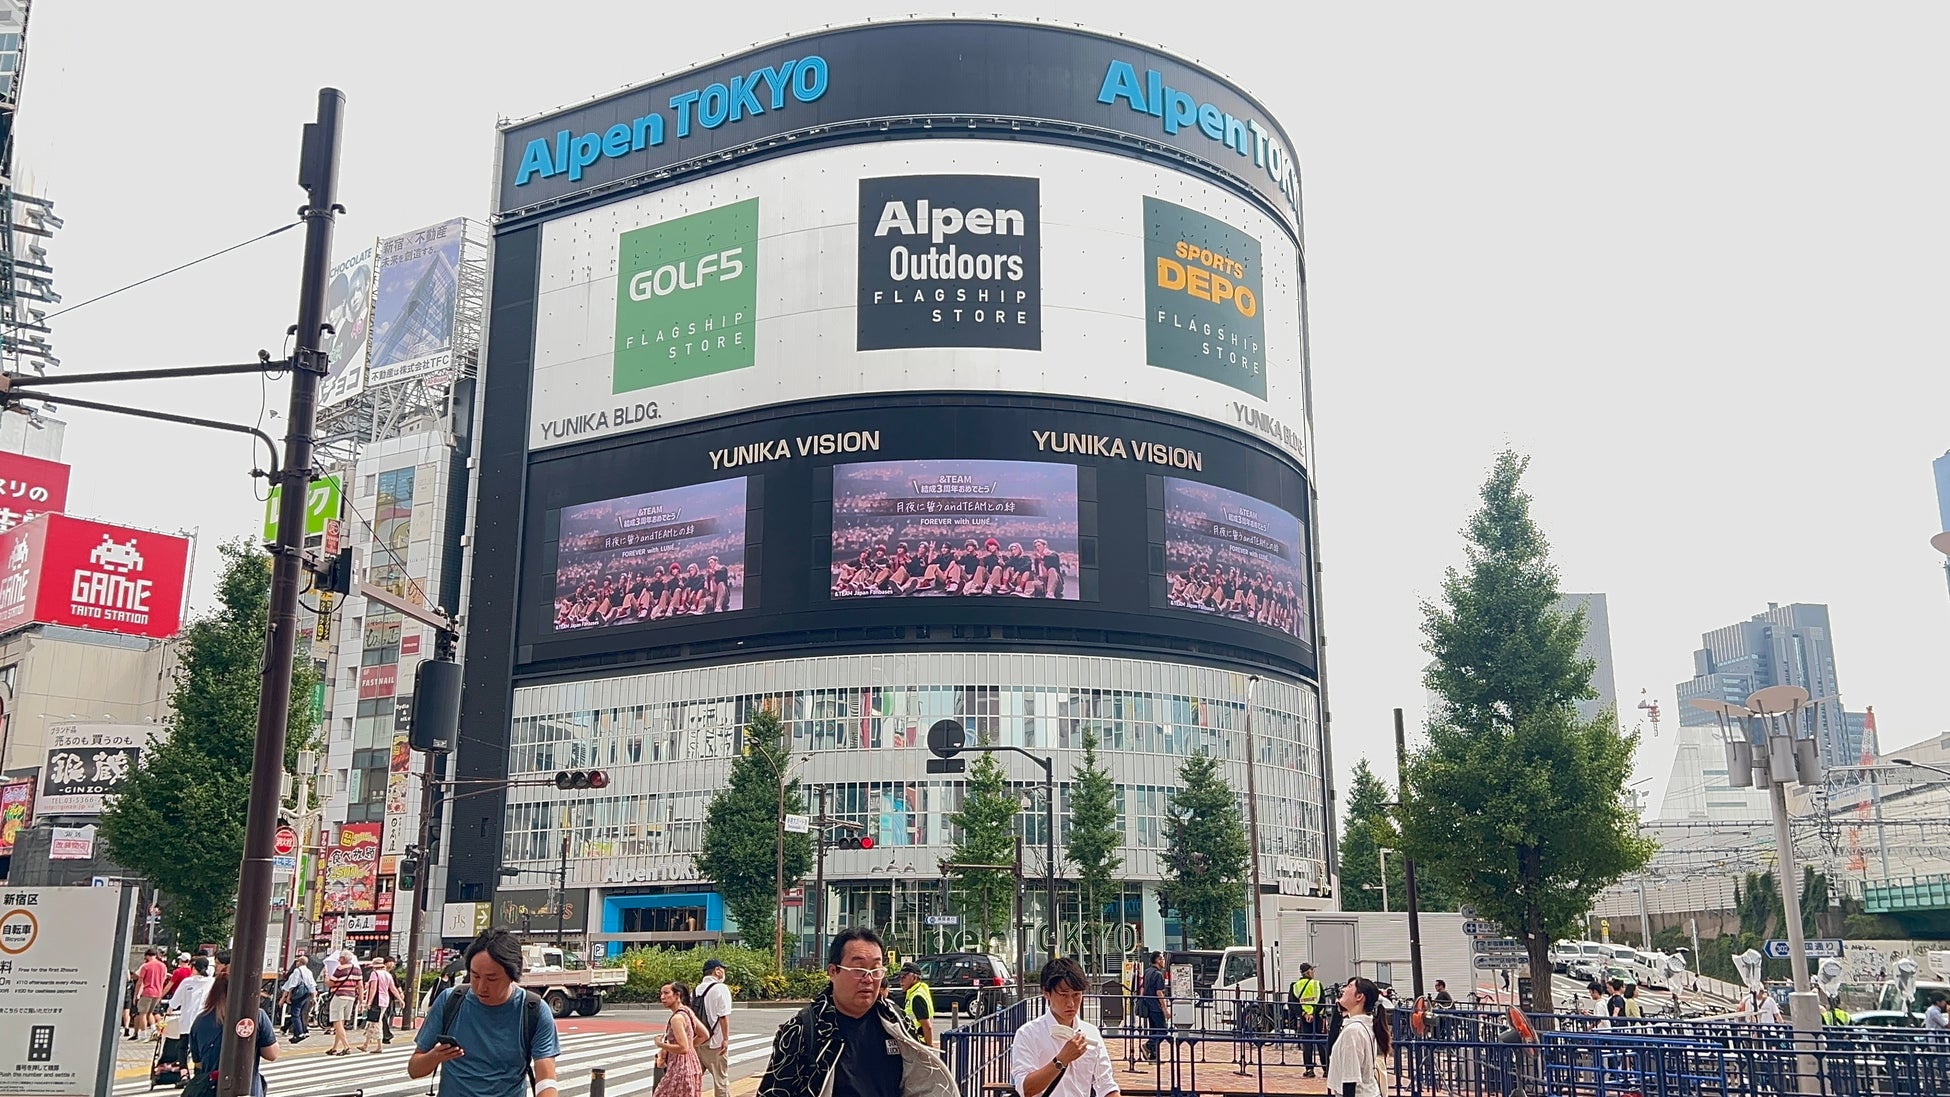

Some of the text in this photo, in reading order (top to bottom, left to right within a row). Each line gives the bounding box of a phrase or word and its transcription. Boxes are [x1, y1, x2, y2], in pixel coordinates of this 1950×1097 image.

[514, 55, 829, 186] Alpen TOKYO
[1097, 59, 1249, 157] Alpen
[874, 199, 1025, 244] Alpen
[629, 247, 743, 302] GOLF5
[890, 244, 1024, 281] Outdoors
[1175, 240, 1244, 280] SPORTS
[874, 289, 1026, 305] FLAGSHIP
[1157, 256, 1257, 319] DEPO
[626, 312, 743, 349] FLAGSHIP
[932, 309, 1027, 324] STORE
[1157, 310, 1258, 354] FLAGSHIP
[668, 332, 743, 359] STORE
[1202, 342, 1259, 375] STORE
[541, 401, 662, 441] YUNIKA BLDG.
[1233, 401, 1283, 441] YUNIKA
[709, 430, 880, 470] YUNIKA VISION
[1032, 430, 1202, 471] YUNIKA VISION
[939, 475, 972, 484] &TEAM
[637, 505, 663, 517] &TEAM
[920, 518, 952, 526] FOREVER
[954, 517, 970, 525] with
[622, 548, 646, 558] FOREVER
[71, 569, 153, 612] GAME
[70, 604, 149, 625] TAITO STATION
[362, 676, 395, 687] FASTNAIL
[604, 862, 658, 886] Alpen
[1277, 877, 1310, 896] TOKYO
[3, 893, 39, 906] 新宿区
[2, 924, 32, 935] 自転車
